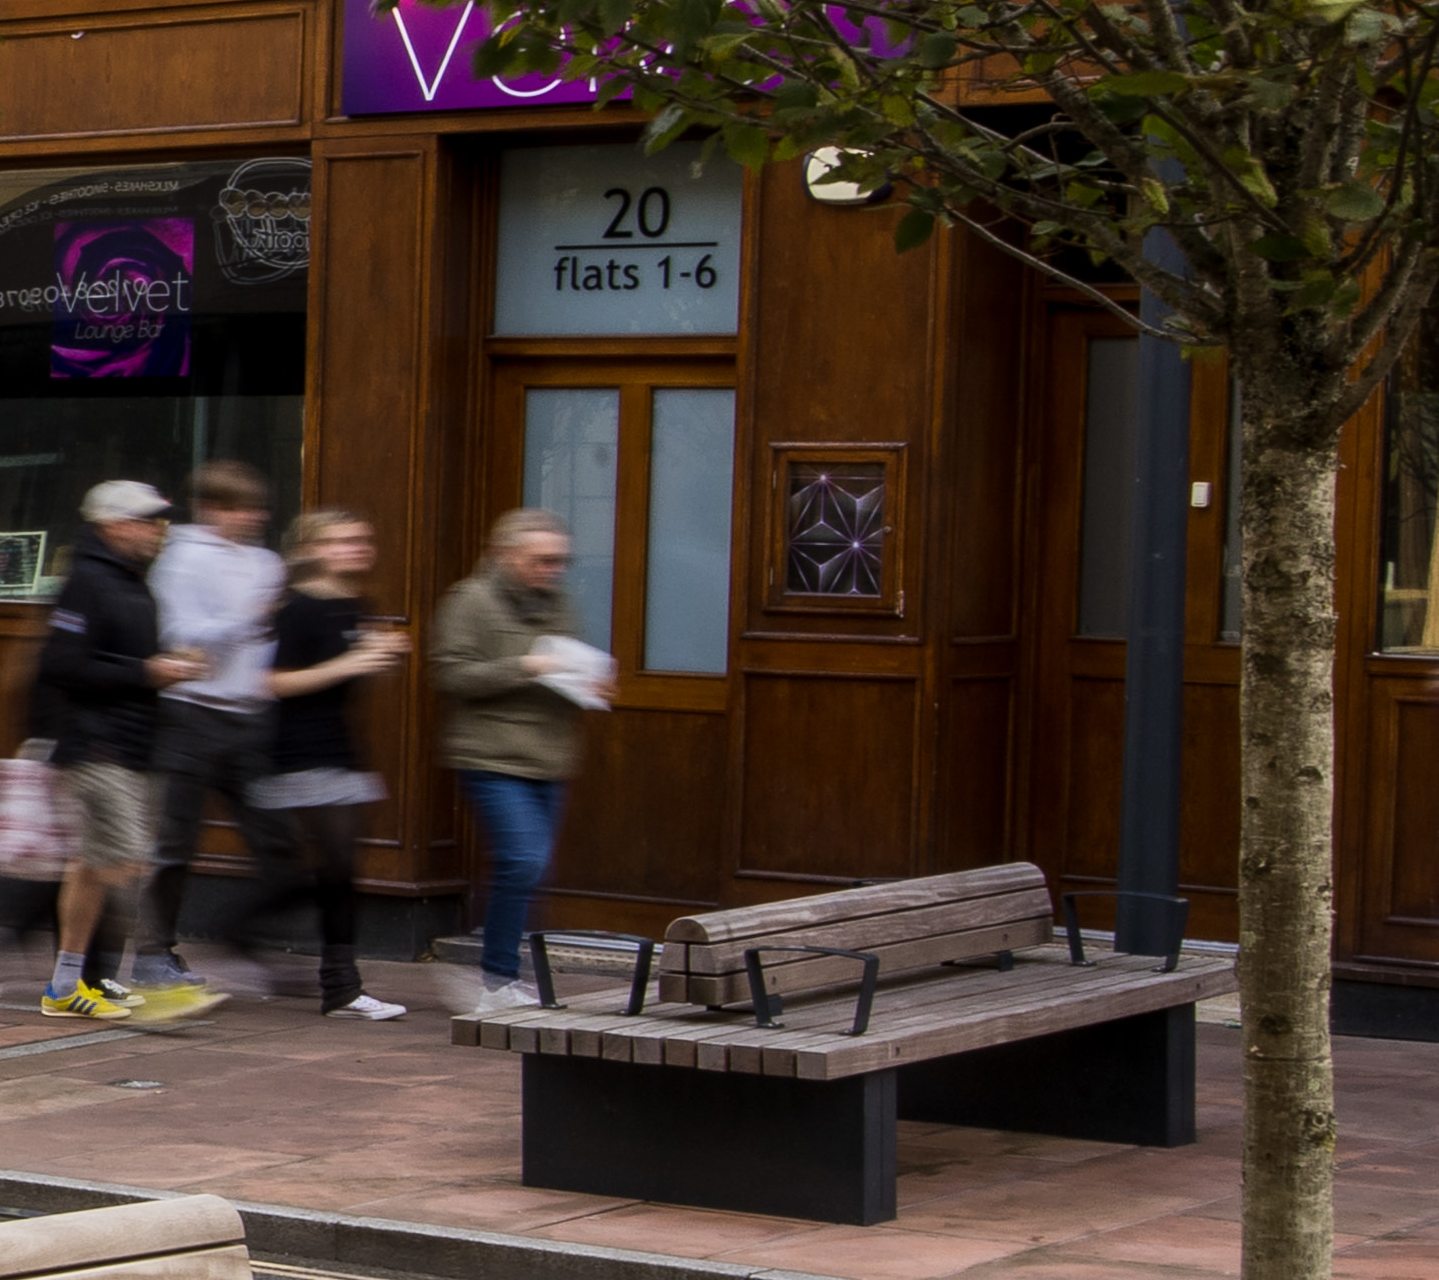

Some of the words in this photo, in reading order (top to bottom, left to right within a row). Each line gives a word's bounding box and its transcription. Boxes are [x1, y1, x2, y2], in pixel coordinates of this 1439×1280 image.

[602, 186, 671, 239] 20
[55, 269, 191, 314] Velvet
[554, 255, 640, 291] flats
[657, 253, 717, 290] 1-6
[74, 321, 135, 344] Lounge
[137, 319, 166, 339] Bar
